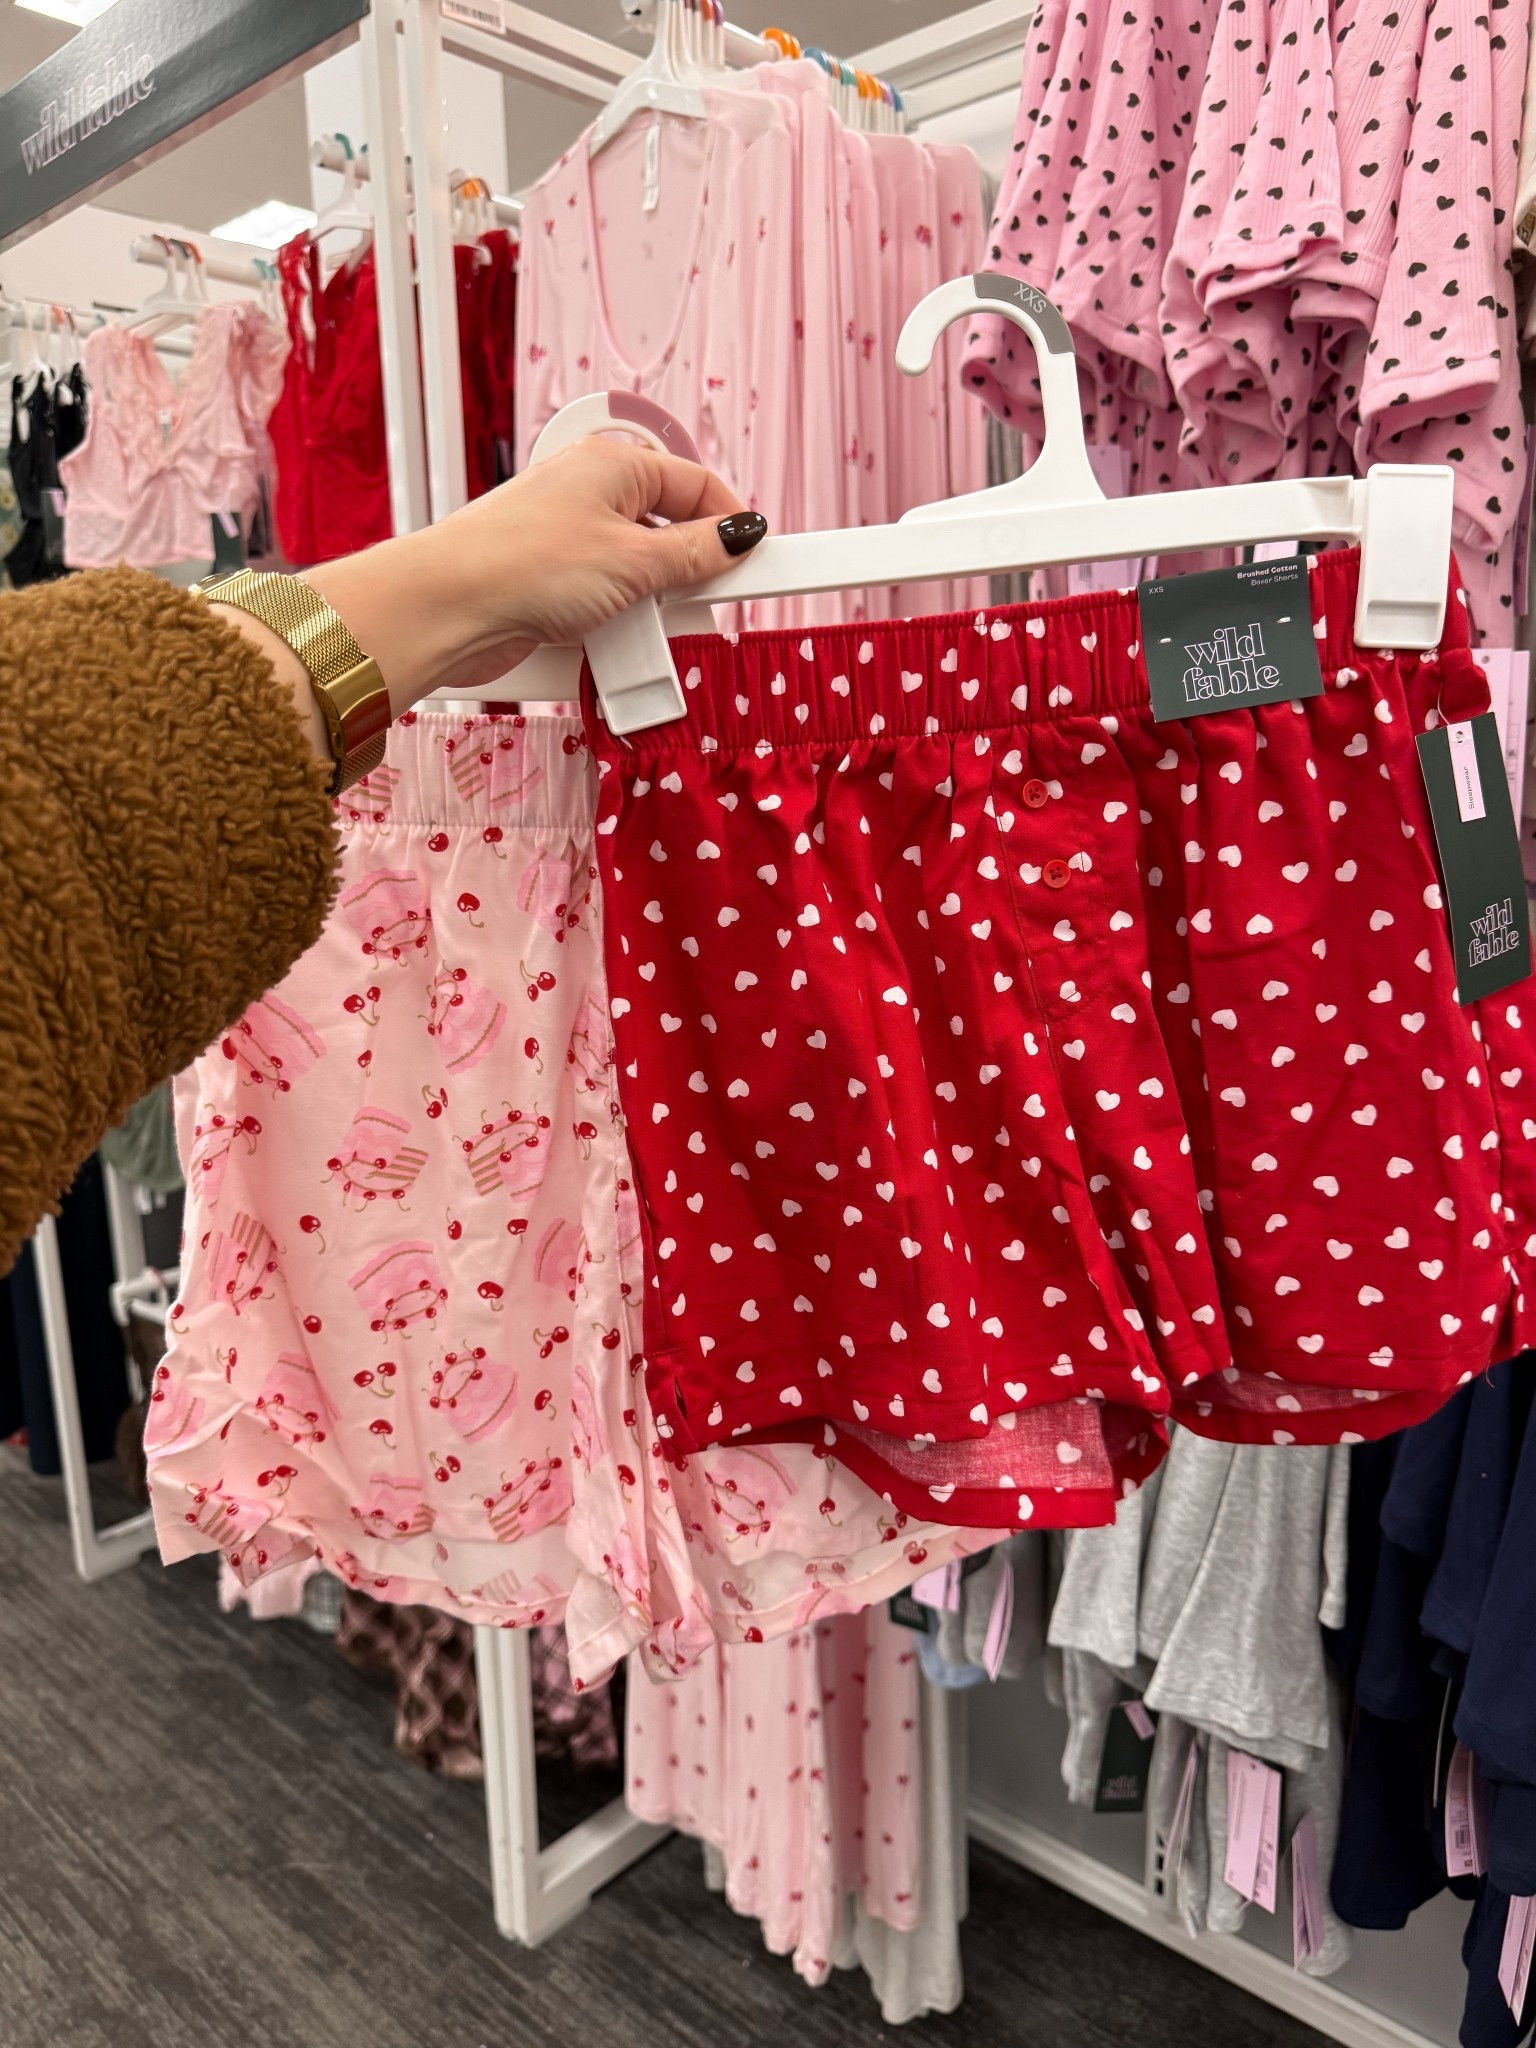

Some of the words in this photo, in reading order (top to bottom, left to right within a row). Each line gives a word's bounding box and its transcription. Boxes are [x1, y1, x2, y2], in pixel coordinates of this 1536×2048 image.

[20, 86, 78, 176] wild
[78, 42, 155, 142] fable
[1012, 282, 1047, 314] XXS
[661, 420, 673, 438] L
[1148, 585, 1164, 595] XXS
[1237, 567, 1270, 580] Brushed
[1270, 563, 1298, 574] Cotton
[1250, 575, 1273, 587] Boxer
[1273, 573, 1299, 582] Shorts
[1184, 622, 1265, 666] wild
[1181, 657, 1280, 703] fable
[1463, 765, 1475, 810] Sleepwear
[1469, 897, 1514, 938] wild
[1468, 926, 1520, 968] fable
